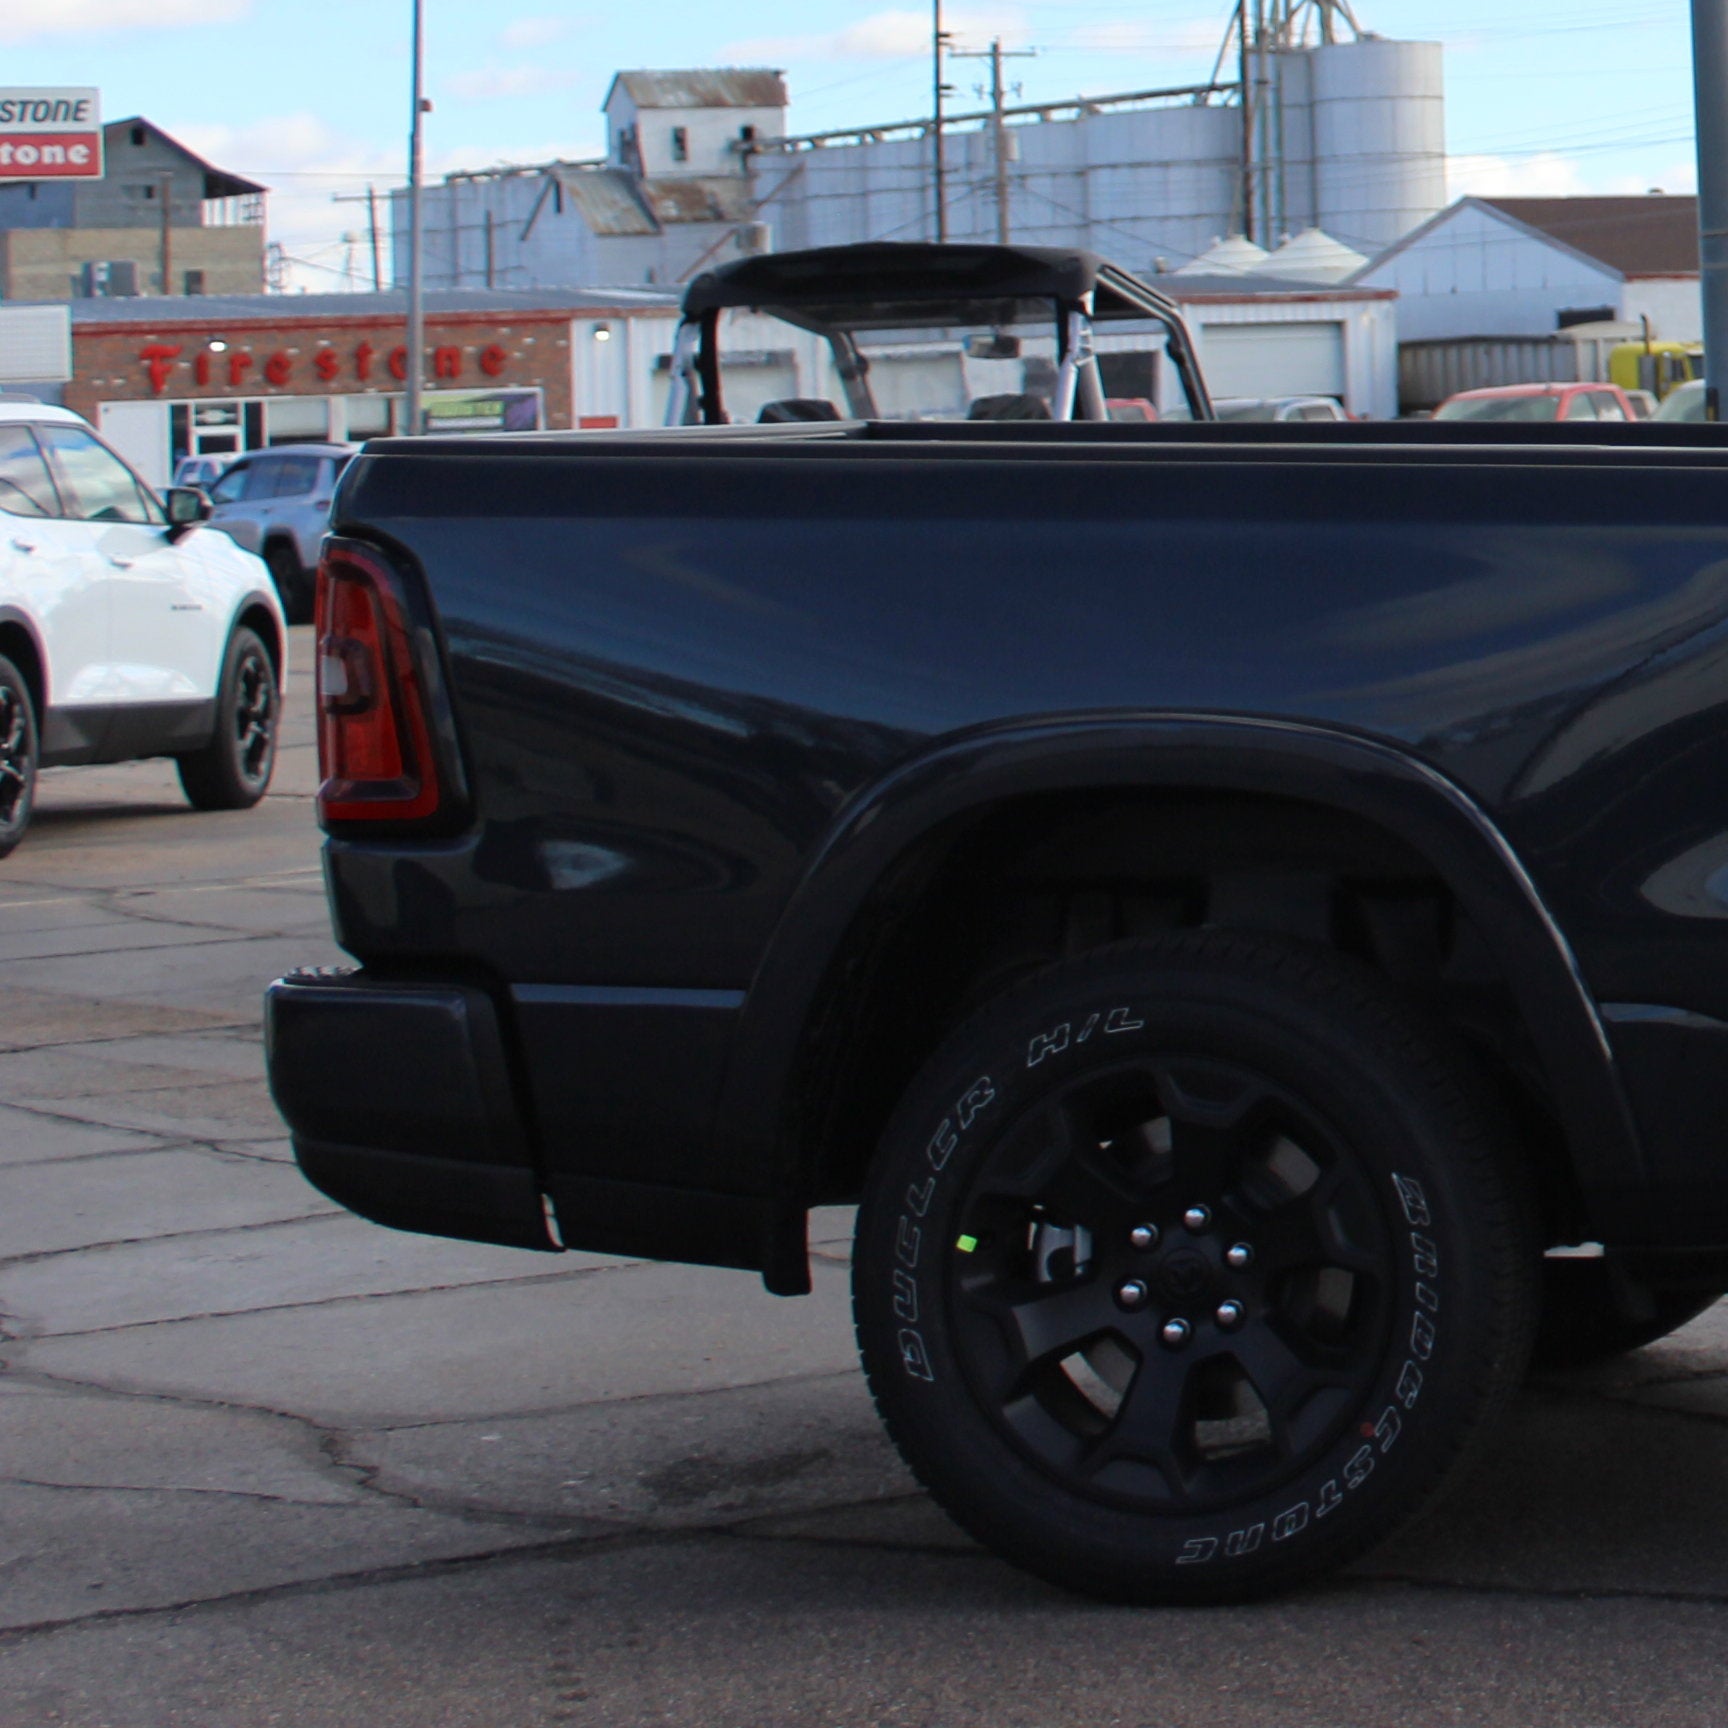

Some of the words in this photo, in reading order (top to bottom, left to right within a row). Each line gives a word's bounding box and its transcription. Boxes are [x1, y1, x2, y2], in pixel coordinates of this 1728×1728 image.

[889, 1075, 995, 1381] DUELER
[1026, 1006, 1144, 1068] H/L
[1174, 1172, 1442, 1565] BRIDGESTONE
